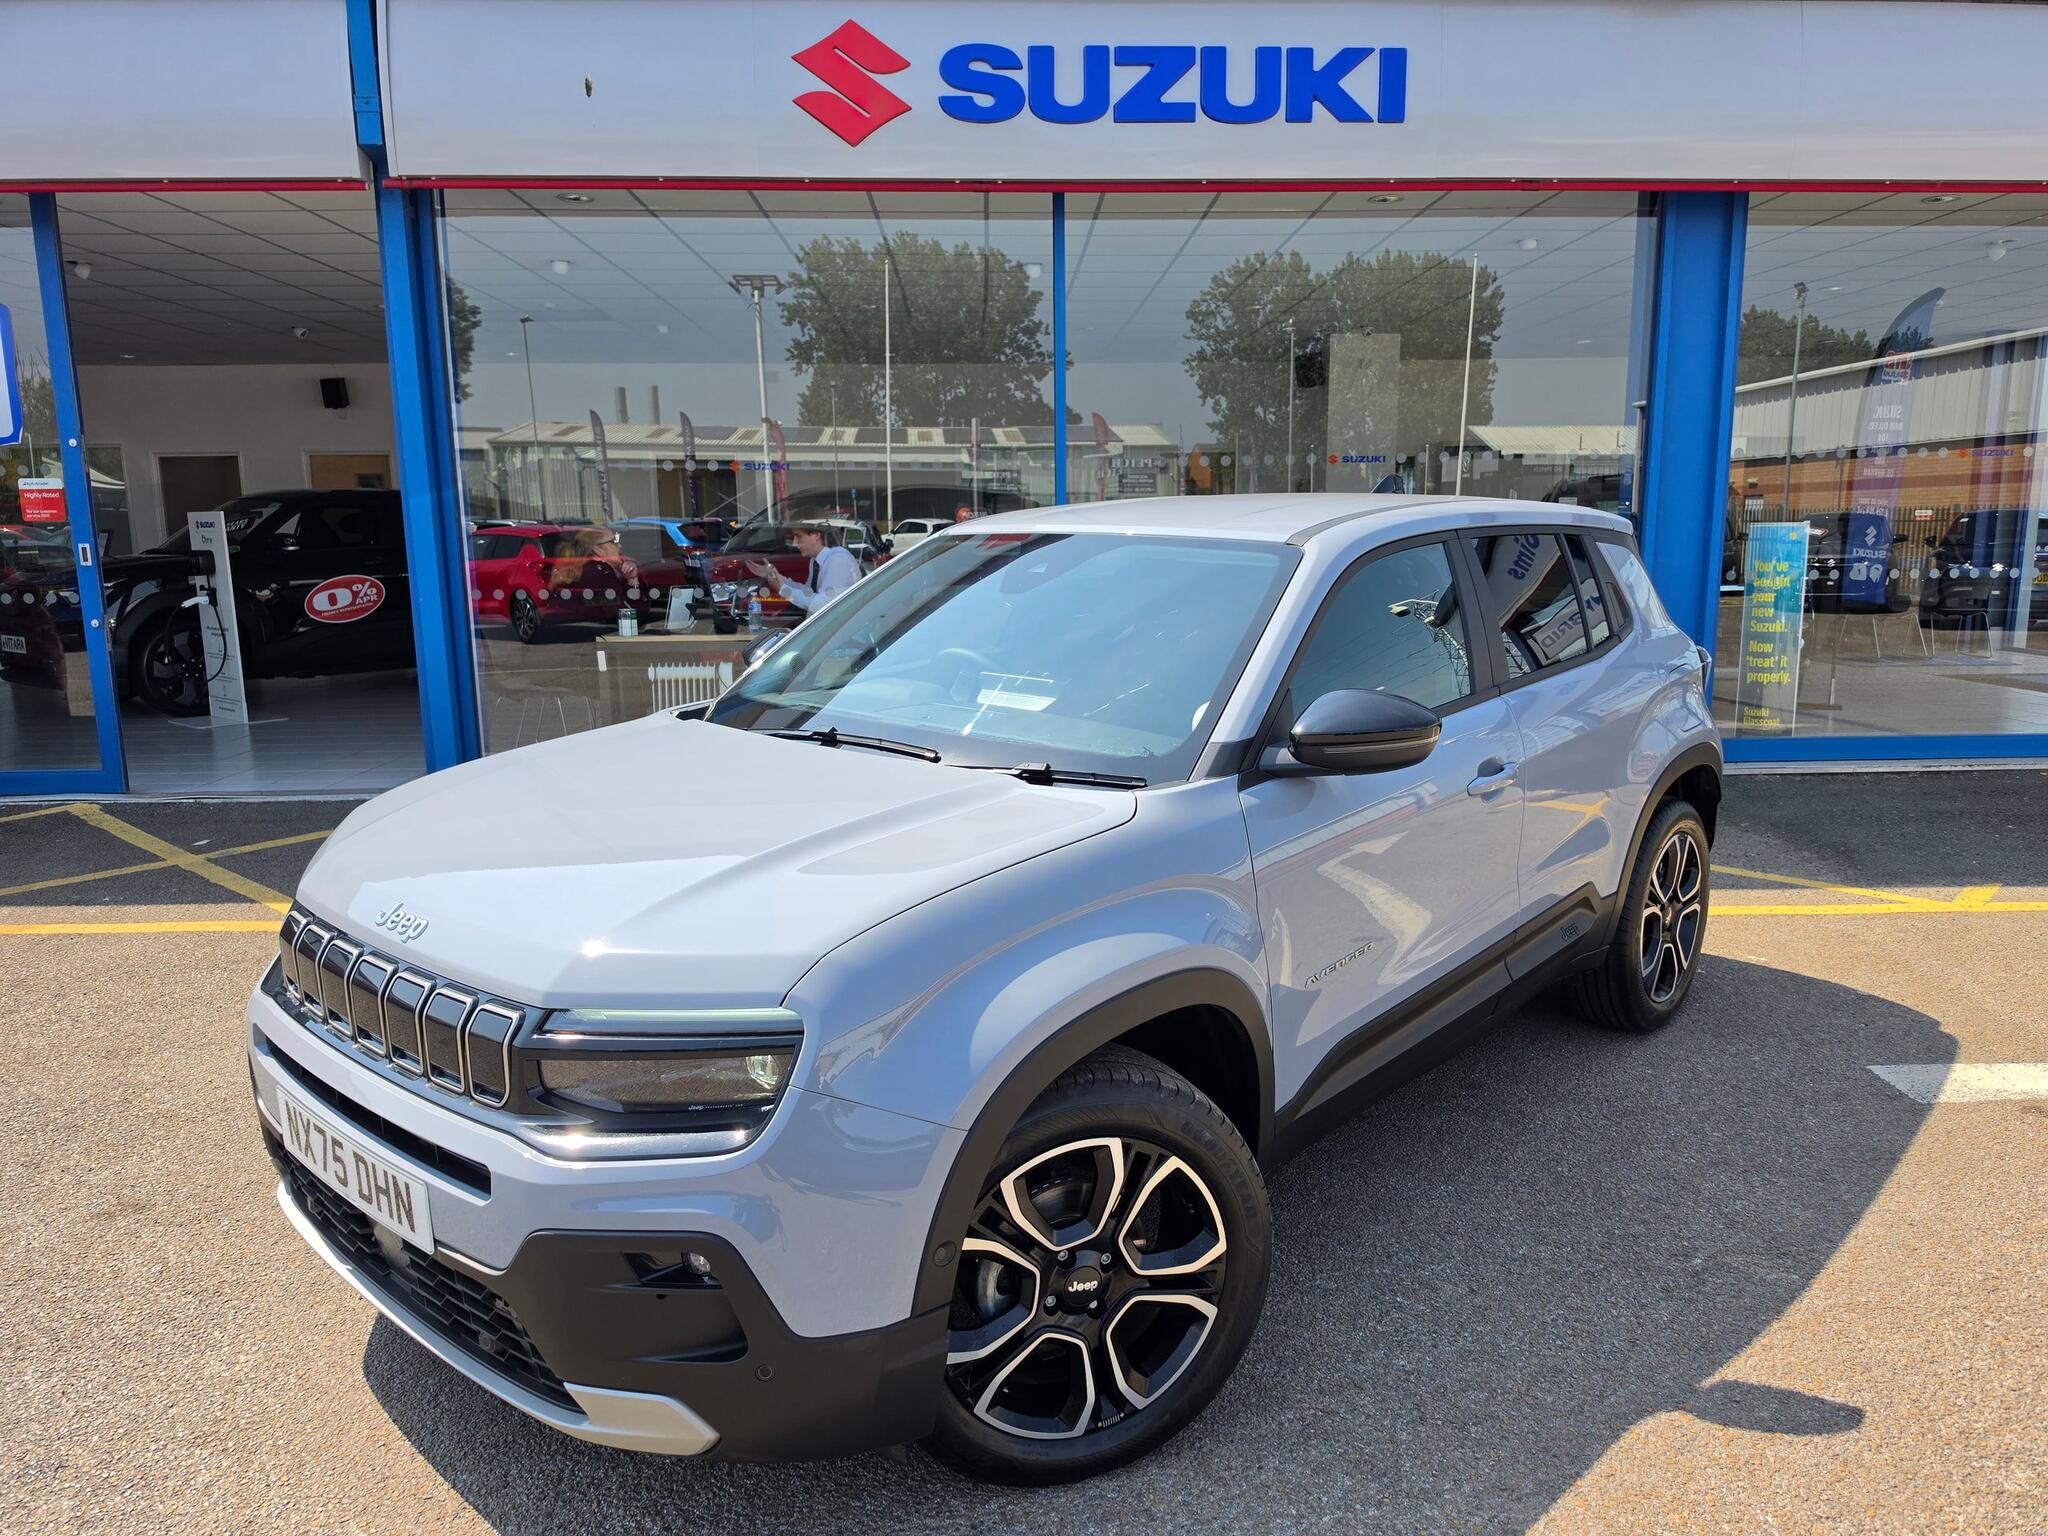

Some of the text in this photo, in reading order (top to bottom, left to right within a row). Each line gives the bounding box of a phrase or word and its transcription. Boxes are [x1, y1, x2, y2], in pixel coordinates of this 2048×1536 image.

[938, 43, 1407, 124] SUZUKI
[1342, 455, 1386, 463] SUZUKI
[743, 462, 790, 471] SUZUKI
[355, 594, 378, 605] APR
[1751, 592, 1776, 604] your
[1751, 607, 1775, 618] new
[1750, 620, 1788, 633] Suzuki.
[1748, 640, 1774, 653] Now
[1780, 655, 1789, 668] it
[1746, 670, 1791, 685] properly.
[1743, 706, 1769, 718] Suzuki
[375, 902, 430, 945] Jeep
[284, 1098, 416, 1234] NX75 DHN
[1068, 1280, 1099, 1292] Jeep
